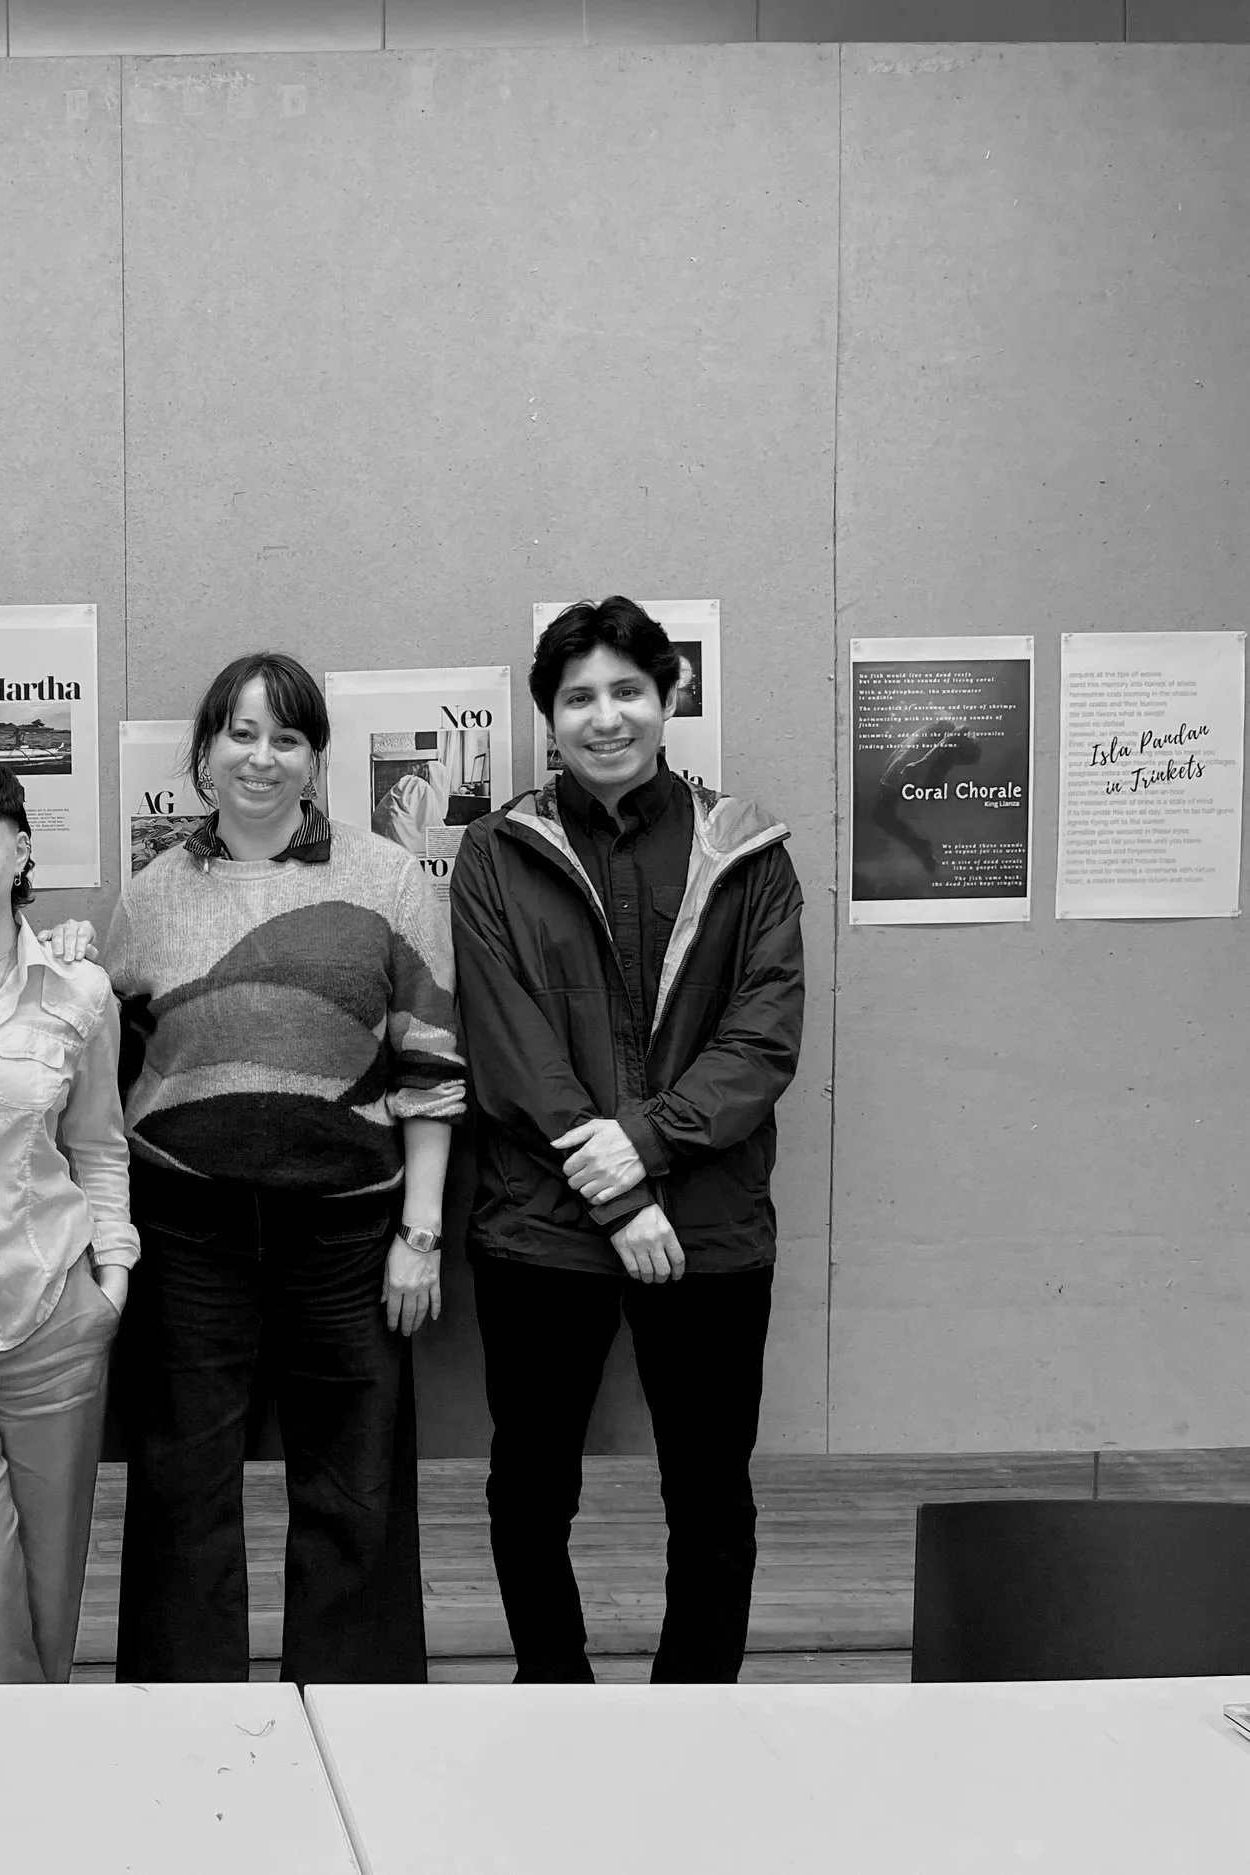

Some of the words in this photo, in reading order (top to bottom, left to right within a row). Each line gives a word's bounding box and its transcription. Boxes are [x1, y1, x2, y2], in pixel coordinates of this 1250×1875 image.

[440, 705, 492, 729] Neo
[1090, 736, 1133, 767] Isla
[1140, 722, 1209, 754] Pandan
[1106, 782, 1122, 795] in
[1131, 755, 1206, 792] Trinkets
[135, 791, 176, 814] AG
[902, 783, 948, 800] Coral
[956, 781, 1022, 798] Chorale
